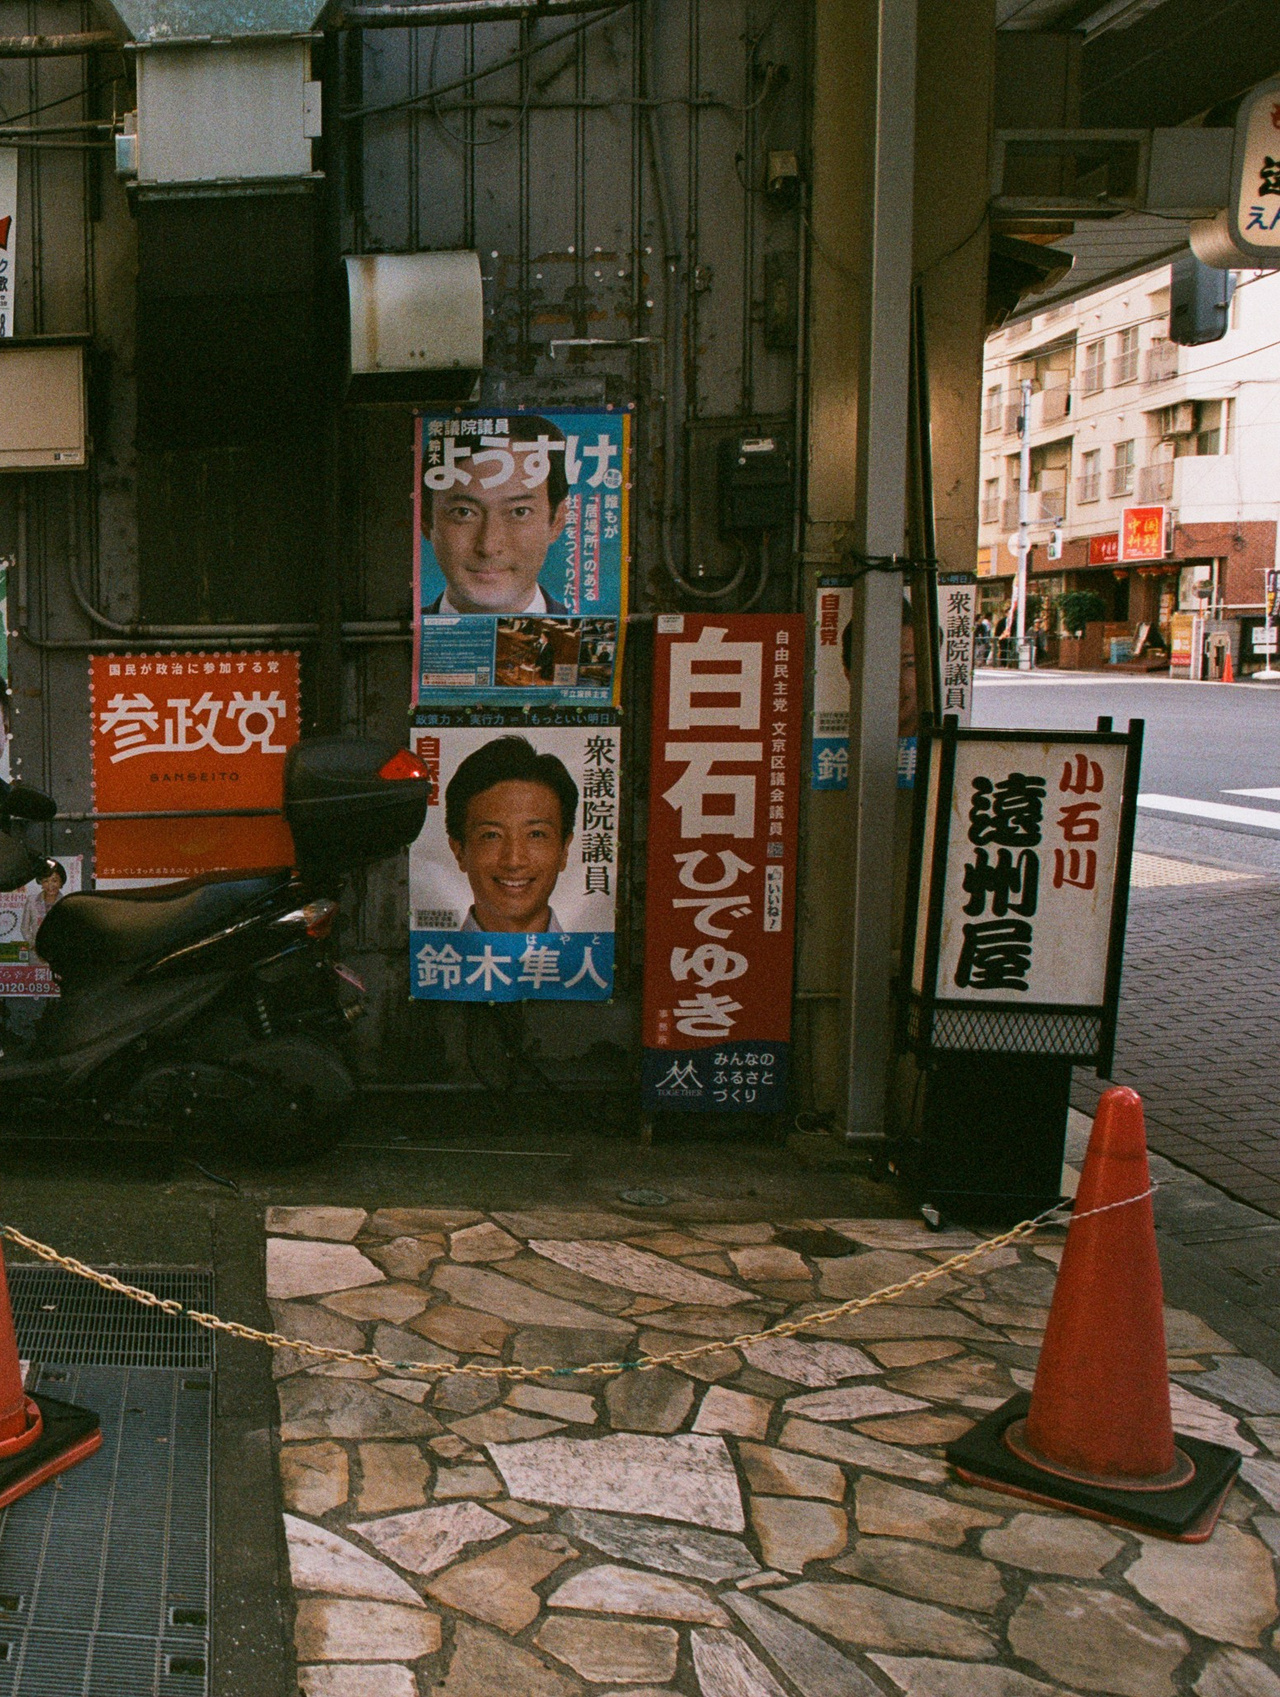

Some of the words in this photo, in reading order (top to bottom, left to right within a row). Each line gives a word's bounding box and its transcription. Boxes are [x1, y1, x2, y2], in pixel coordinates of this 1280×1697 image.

[428, 418, 510, 435] 衆議院議員
[423, 434, 618, 491] ようすけ
[821, 594, 840, 646] 自民党
[109, 661, 280, 676] 国民が政治に参加する党
[773, 630, 789, 712] 自由民主党
[944, 591, 971, 710] 衆議院議員
[99, 691, 287, 764] 参政党
[150, 772, 240, 782] SANSEITO
[582, 735, 617, 896] 衆議院議員
[1053, 754, 1104, 890] 小石川
[954, 772, 1047, 992] 遠州屋
[415, 943, 609, 992] 鈴木隼人
[713, 1071, 773, 1085] ふるさと
[714, 1053, 774, 1066] みんなの
[713, 1089, 756, 1103] づくり
